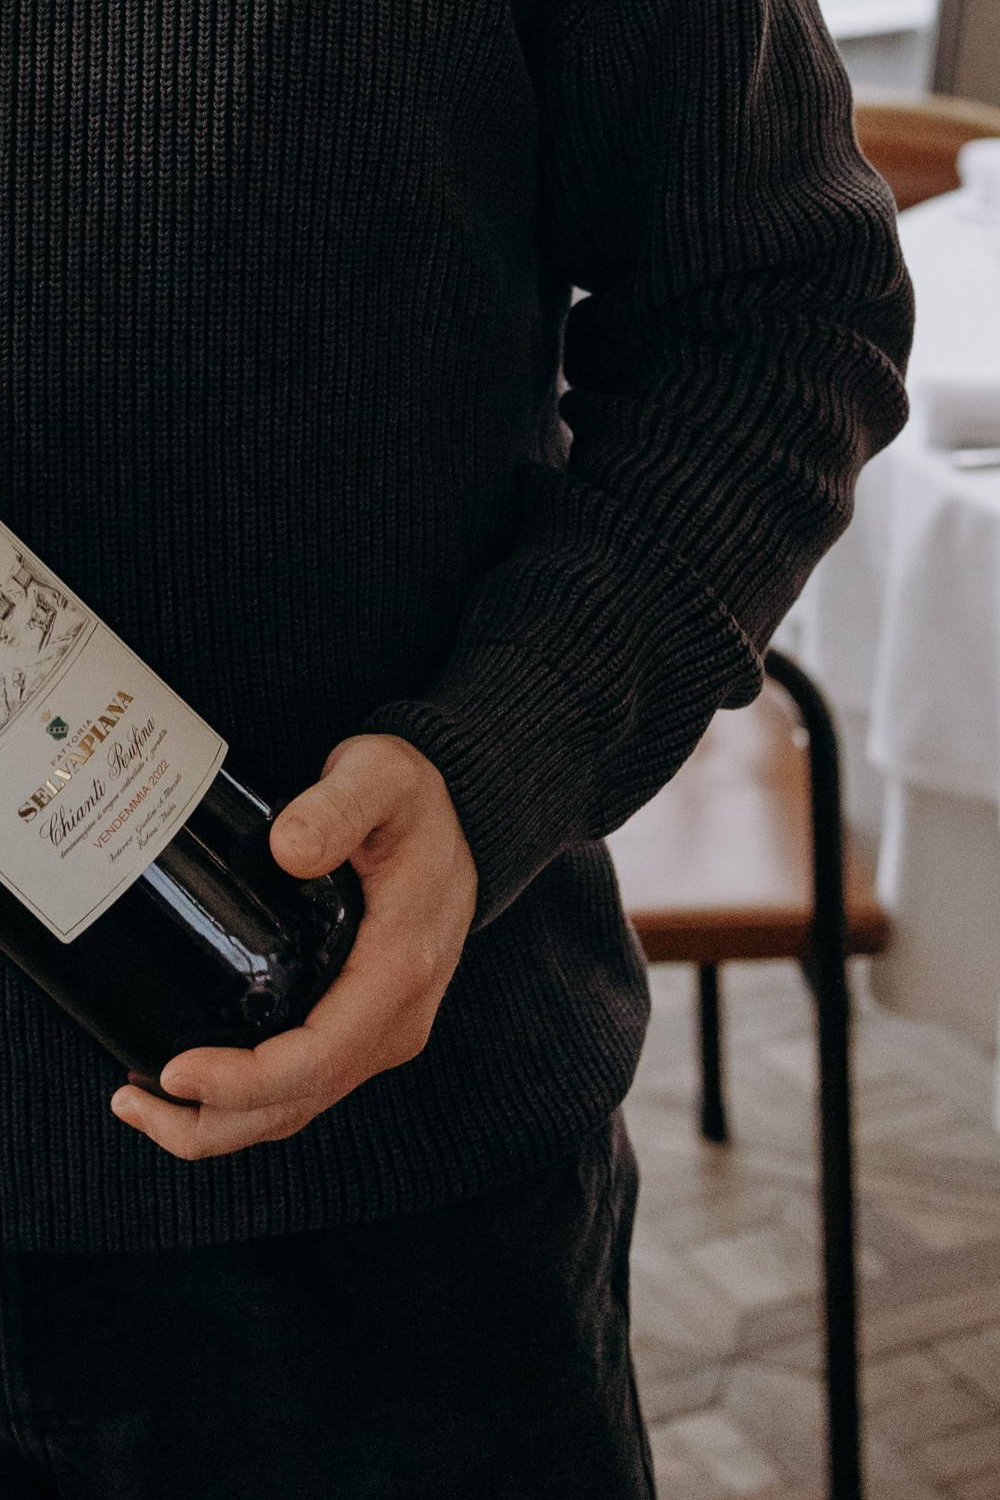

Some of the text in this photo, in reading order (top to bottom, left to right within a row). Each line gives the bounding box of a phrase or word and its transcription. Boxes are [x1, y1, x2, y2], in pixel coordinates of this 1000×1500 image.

[18, 691, 134, 823] SELVAPIANA
[39, 717, 155, 847] Chianti Rufina
[51, 719, 93, 768] FATTORIA
[92, 759, 169, 849] VENDEMMIA 2022
